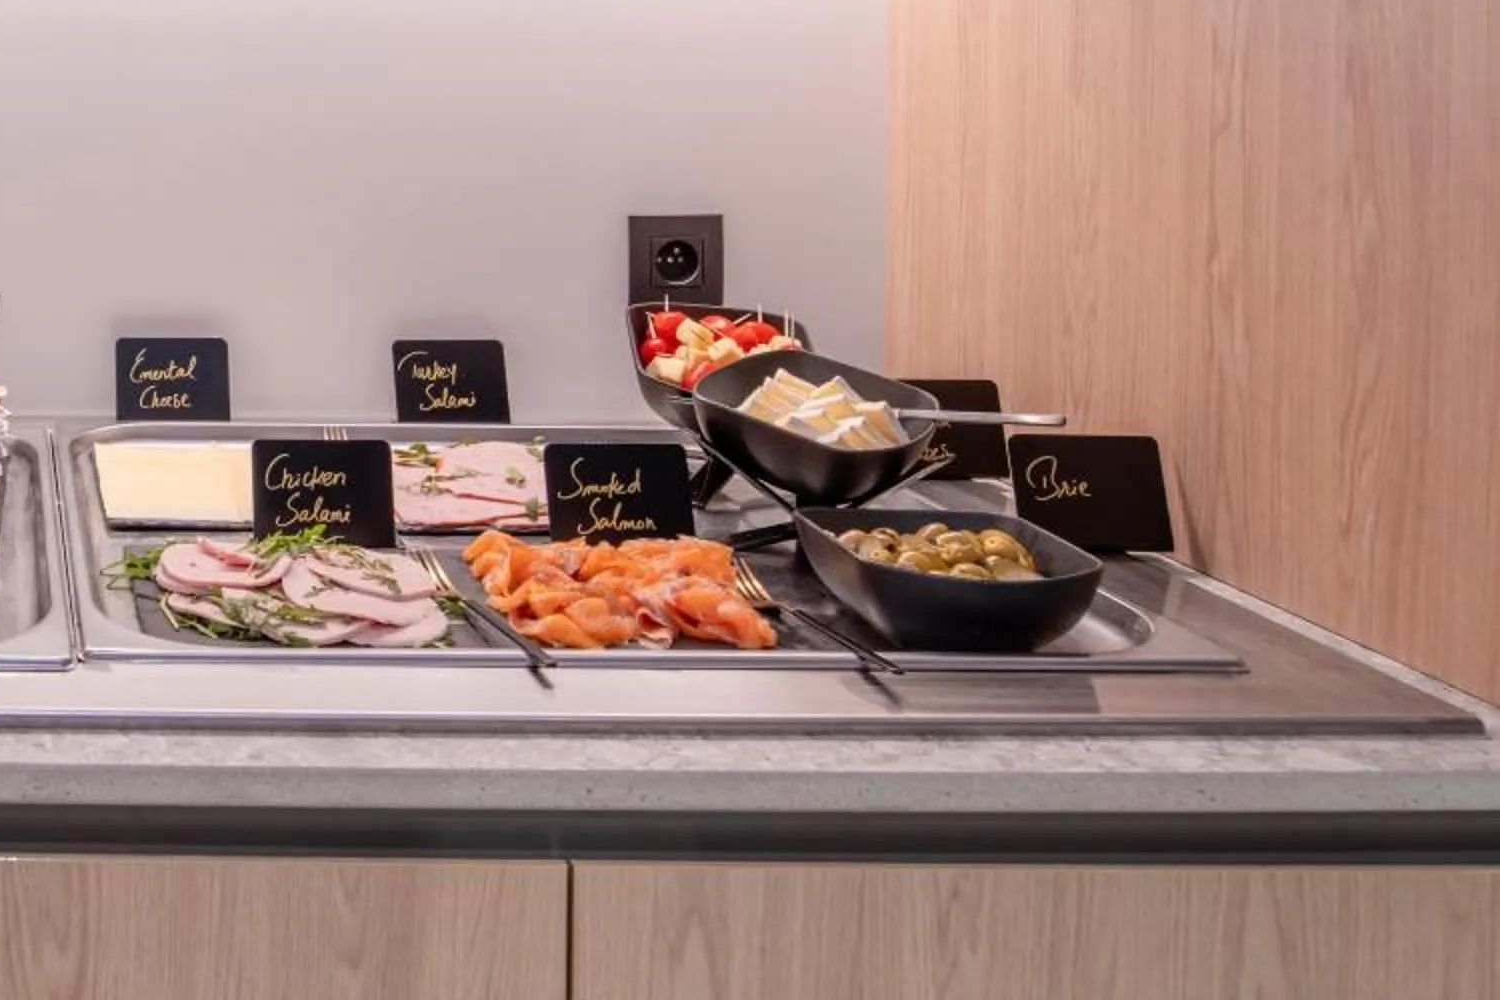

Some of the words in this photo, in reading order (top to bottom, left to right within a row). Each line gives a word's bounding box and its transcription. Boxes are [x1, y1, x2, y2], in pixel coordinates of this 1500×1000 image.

[419, 383, 477, 411] Salami
[264, 453, 347, 491] Chicken
[557, 457, 642, 500] Smoked
[1025, 455, 1092, 500] Brie
[275, 492, 351, 527] Salami
[577, 497, 658, 535] Salmon
